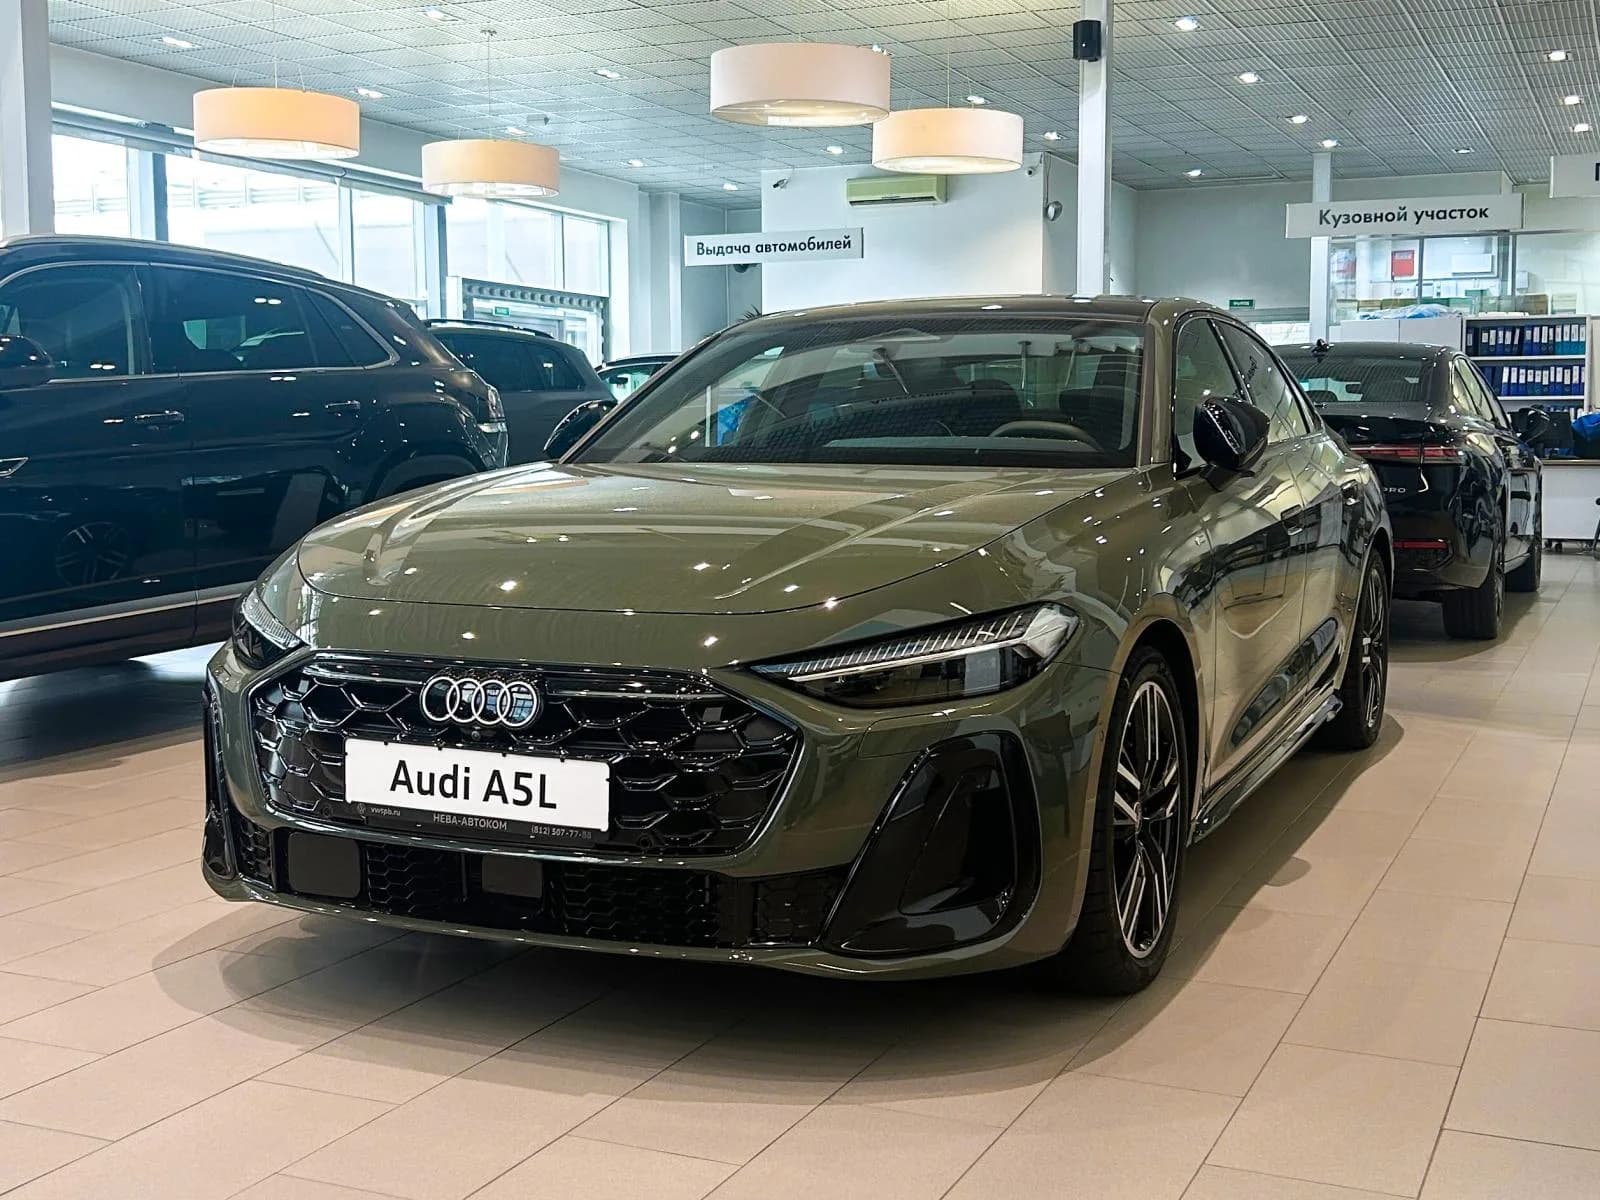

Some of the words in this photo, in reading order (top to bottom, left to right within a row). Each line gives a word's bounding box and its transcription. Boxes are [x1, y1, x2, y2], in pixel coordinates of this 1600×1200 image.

[1319, 207, 1408, 228] Кузовной
[1414, 207, 1489, 224] участок
[696, 242, 751, 256] Выдача
[755, 235, 852, 253] автомобилей
[390, 760, 470, 800] Audi
[482, 769, 557, 809] A5L
[433, 813, 508, 830] НЕВА-АВТОКОМ
[531, 825, 551, 836] (812)
